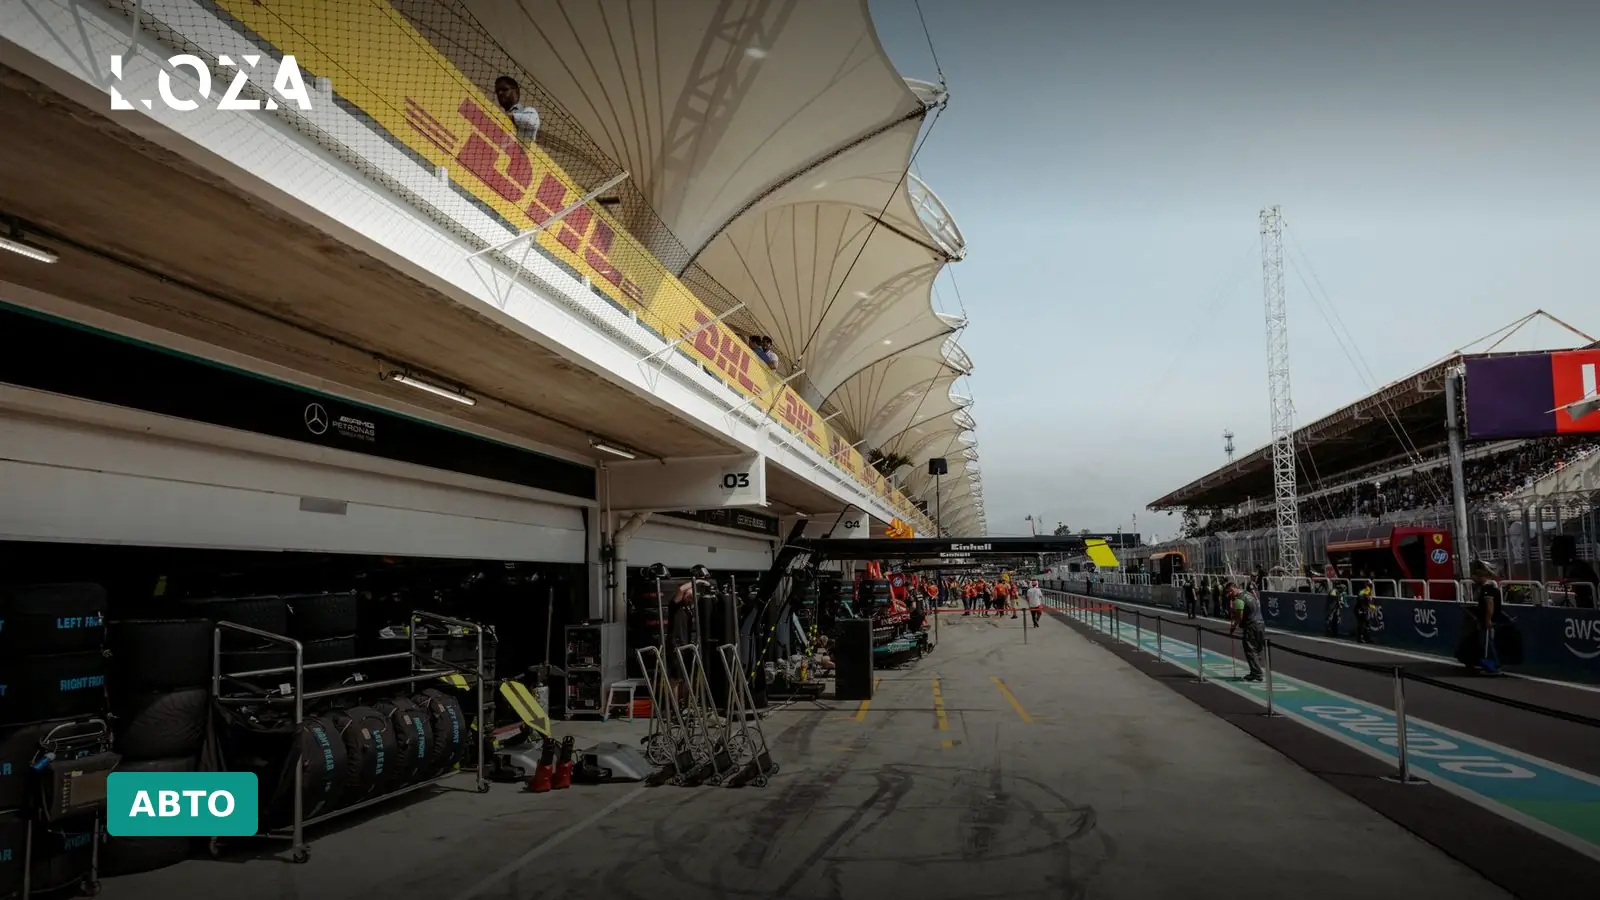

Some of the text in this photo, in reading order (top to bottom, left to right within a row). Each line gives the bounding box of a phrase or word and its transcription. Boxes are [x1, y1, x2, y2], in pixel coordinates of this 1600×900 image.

[456, 97, 624, 288] DHL
[693, 308, 755, 392] DHL
[332, 419, 376, 437] PETRONAS
[844, 520, 861, 529] 04
[950, 543, 992, 551] Einhell
[1433, 550, 1447, 564] hp
[56, 617, 83, 630] LEFT
[1413, 607, 1437, 626] aws
[1564, 617, 1600, 642] aws
[60, 677, 88, 693] RIGHT
[375, 751, 385, 776] REAR
